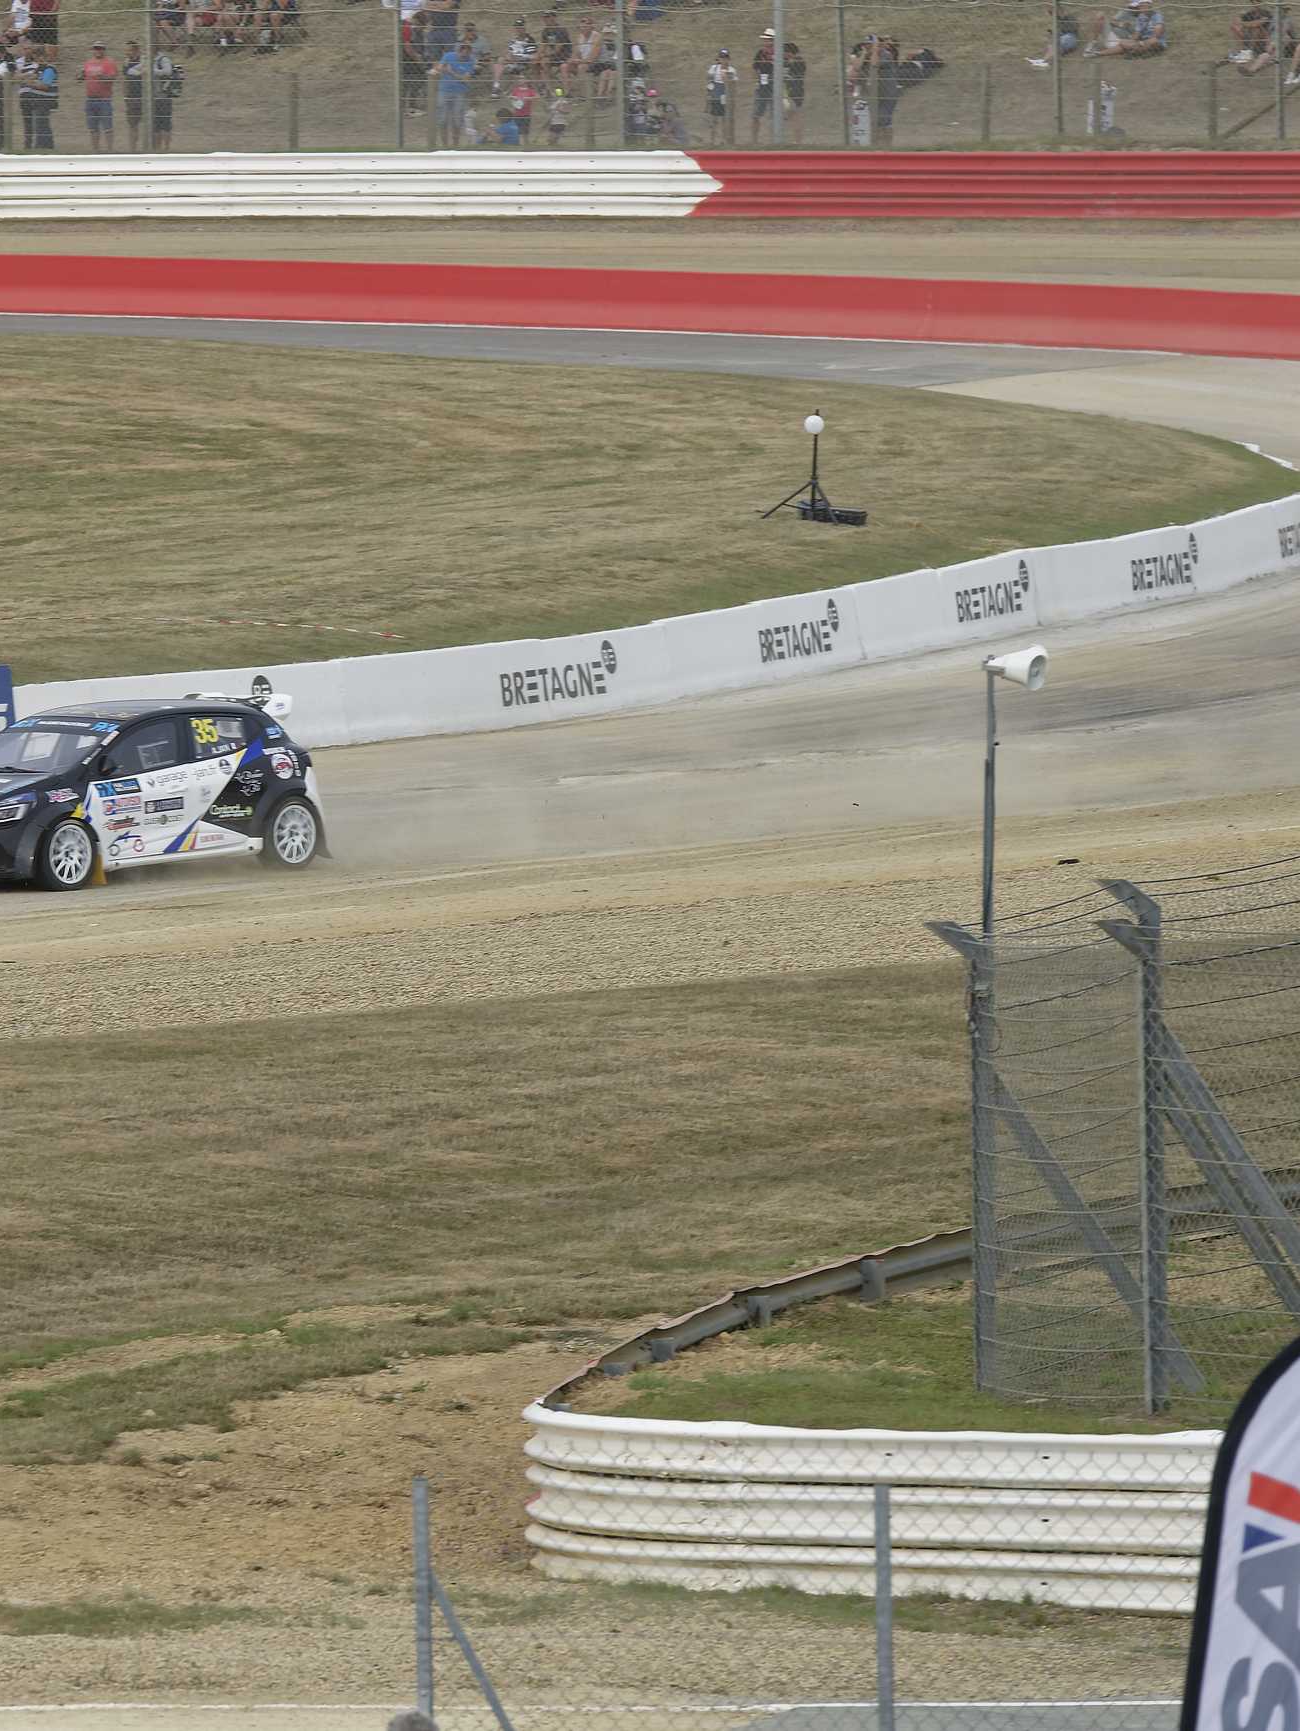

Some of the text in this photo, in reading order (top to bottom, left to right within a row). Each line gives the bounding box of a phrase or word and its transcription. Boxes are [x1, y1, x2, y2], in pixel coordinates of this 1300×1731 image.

[1131, 551, 1192, 591] BRETAGNE
[955, 579, 1023, 623] BRETAGNE
[758, 619, 832, 663] BRETAGNE
[500, 660, 607, 707] BRETAGNE
[191, 718, 219, 744] 35
